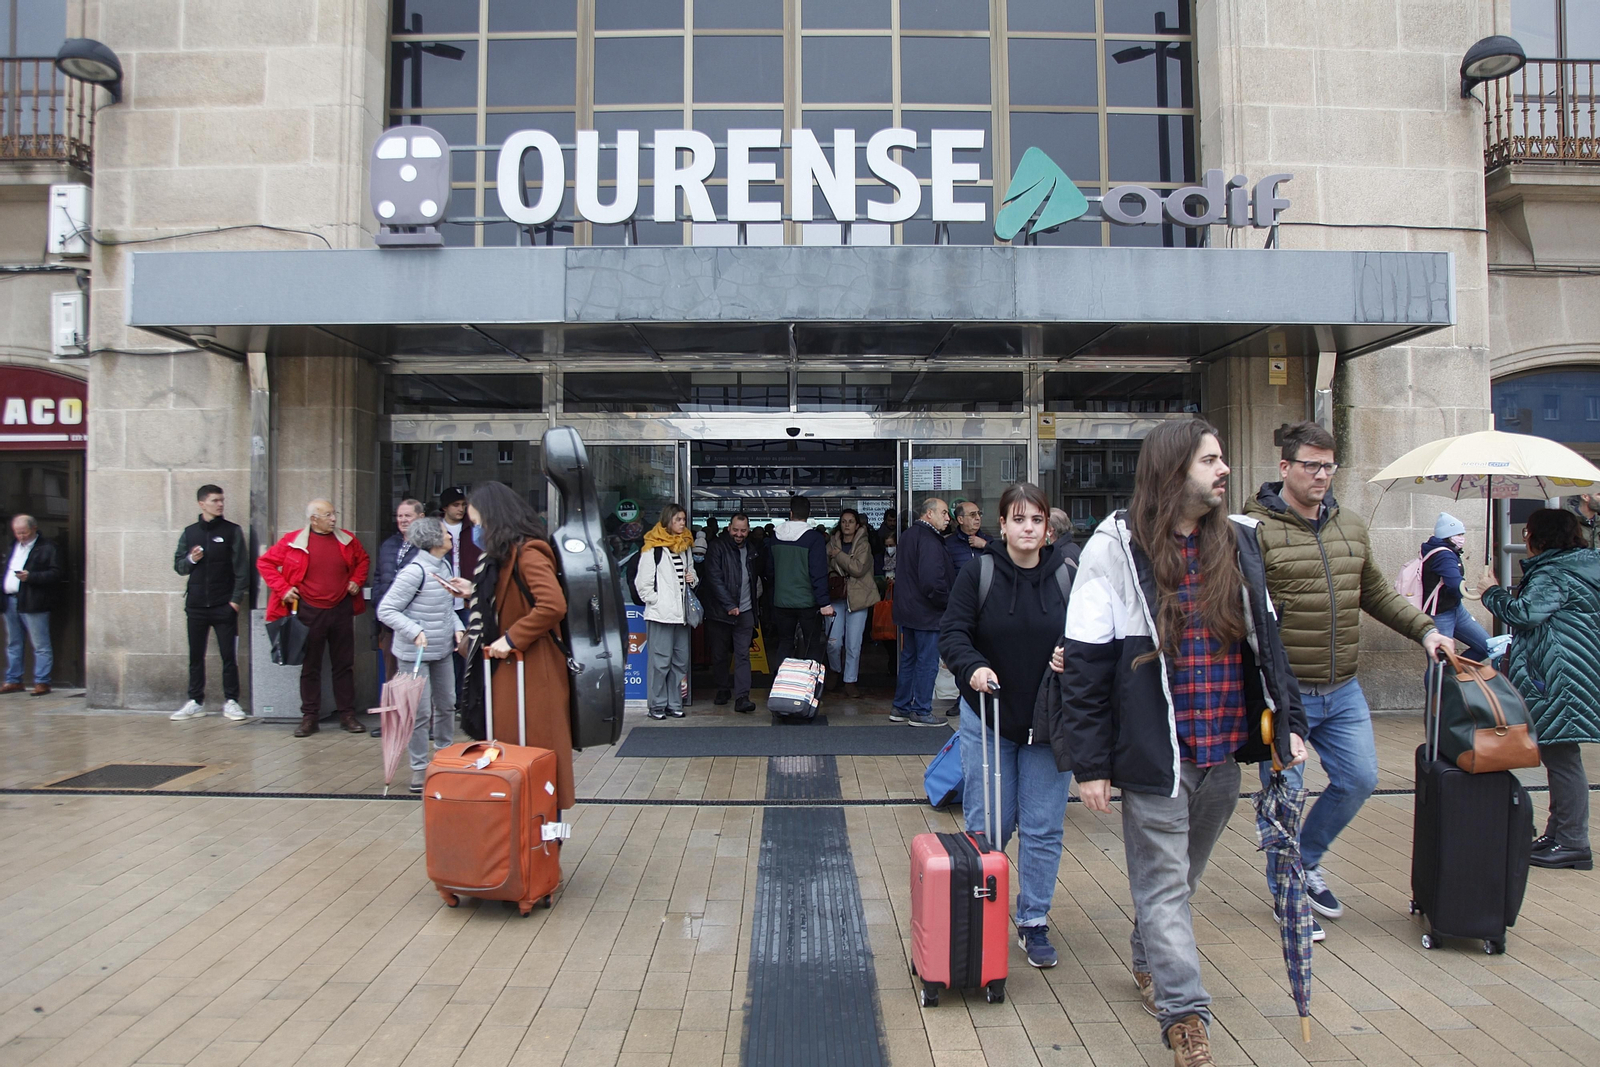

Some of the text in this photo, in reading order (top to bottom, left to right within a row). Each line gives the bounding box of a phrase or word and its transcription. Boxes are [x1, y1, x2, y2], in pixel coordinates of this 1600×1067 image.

[497, 128, 986, 225] OURENSE
[1101, 168, 1294, 228] adif
[3, 398, 82, 425] ACO
